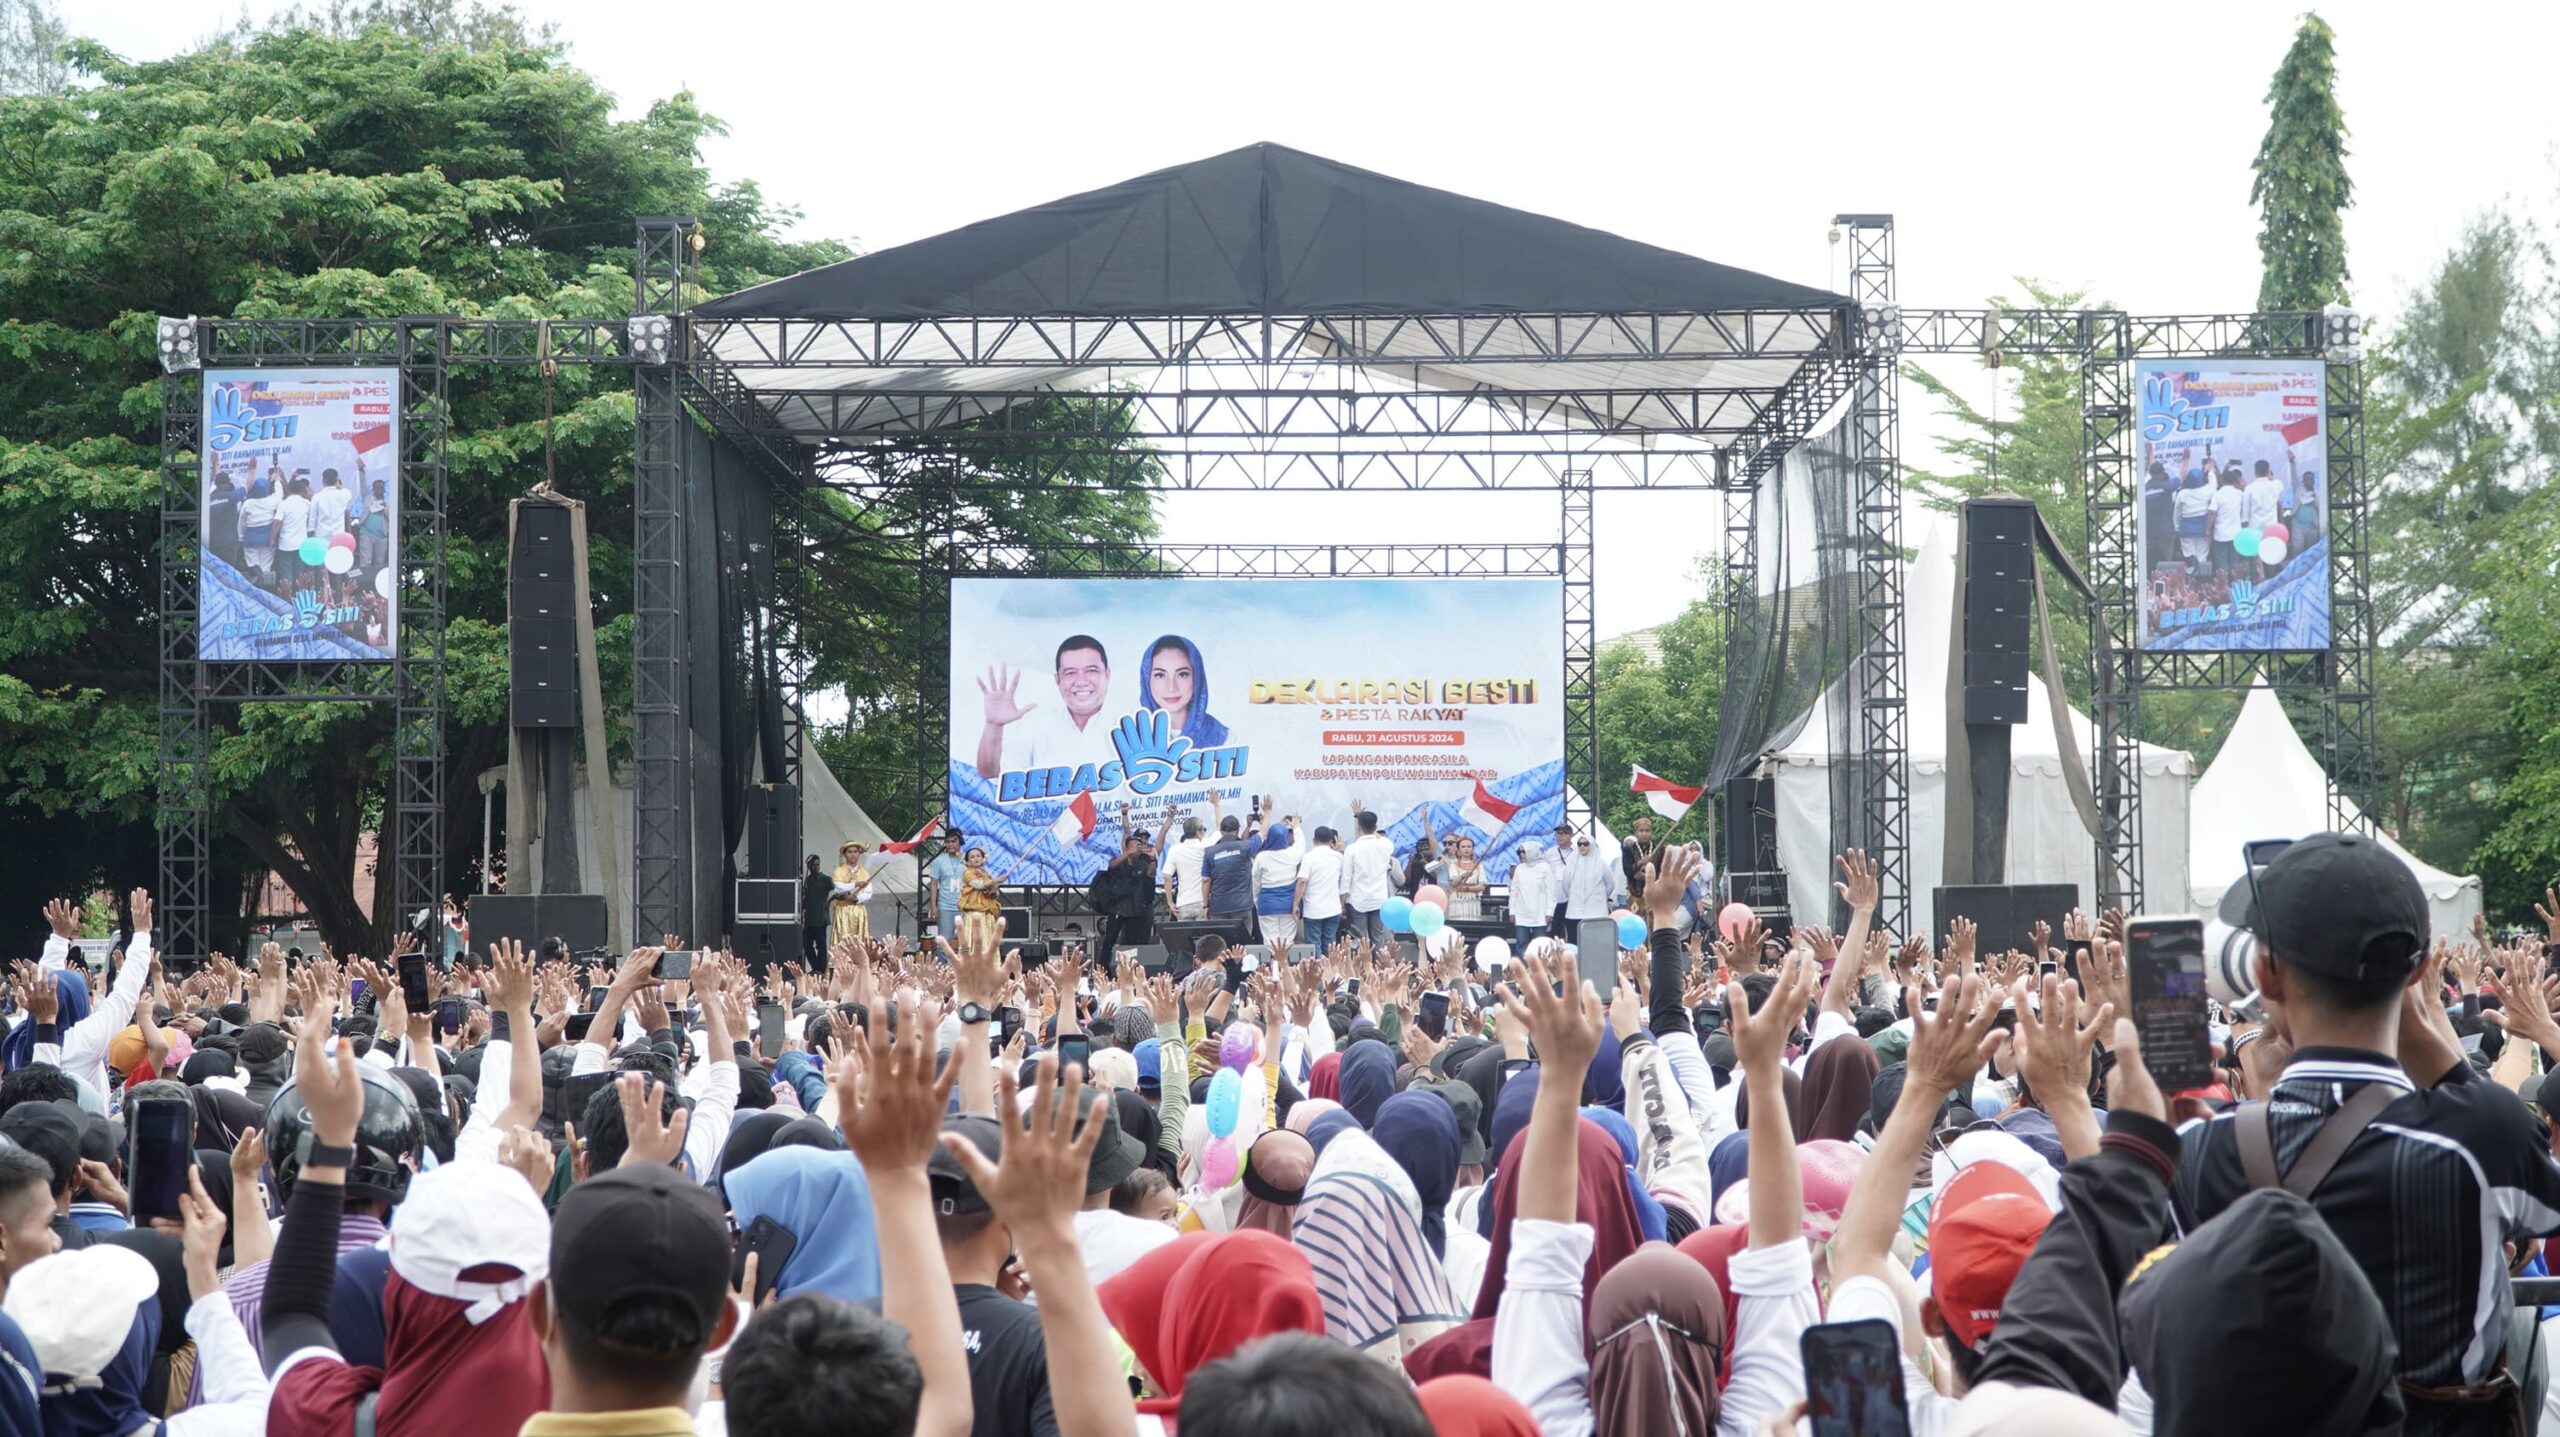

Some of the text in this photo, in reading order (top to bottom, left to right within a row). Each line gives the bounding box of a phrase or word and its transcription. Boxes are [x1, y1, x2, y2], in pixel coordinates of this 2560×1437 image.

[2176, 406, 2230, 432] SITI
[243, 415, 299, 441] SITI
[222, 606, 359, 639] BEBAS SITI
[1249, 678, 1538, 705] DEKLARASI BESTI
[1336, 708, 1392, 721] PESTA
[1398, 708, 1468, 721] RAKYAT
[1331, 734, 1454, 744] RABU, 21 AGUSTUS 2024
[1322, 754, 1469, 766] LAPANGAN PANCASILA
[999, 746, 1249, 803] BEBAS SITI
[1294, 768, 1373, 781] KABUPATEN
[1374, 768, 1438, 781] POLEWALI
[1146, 796, 1161, 809] SITI
[1131, 812, 1158, 822] WAKIL
